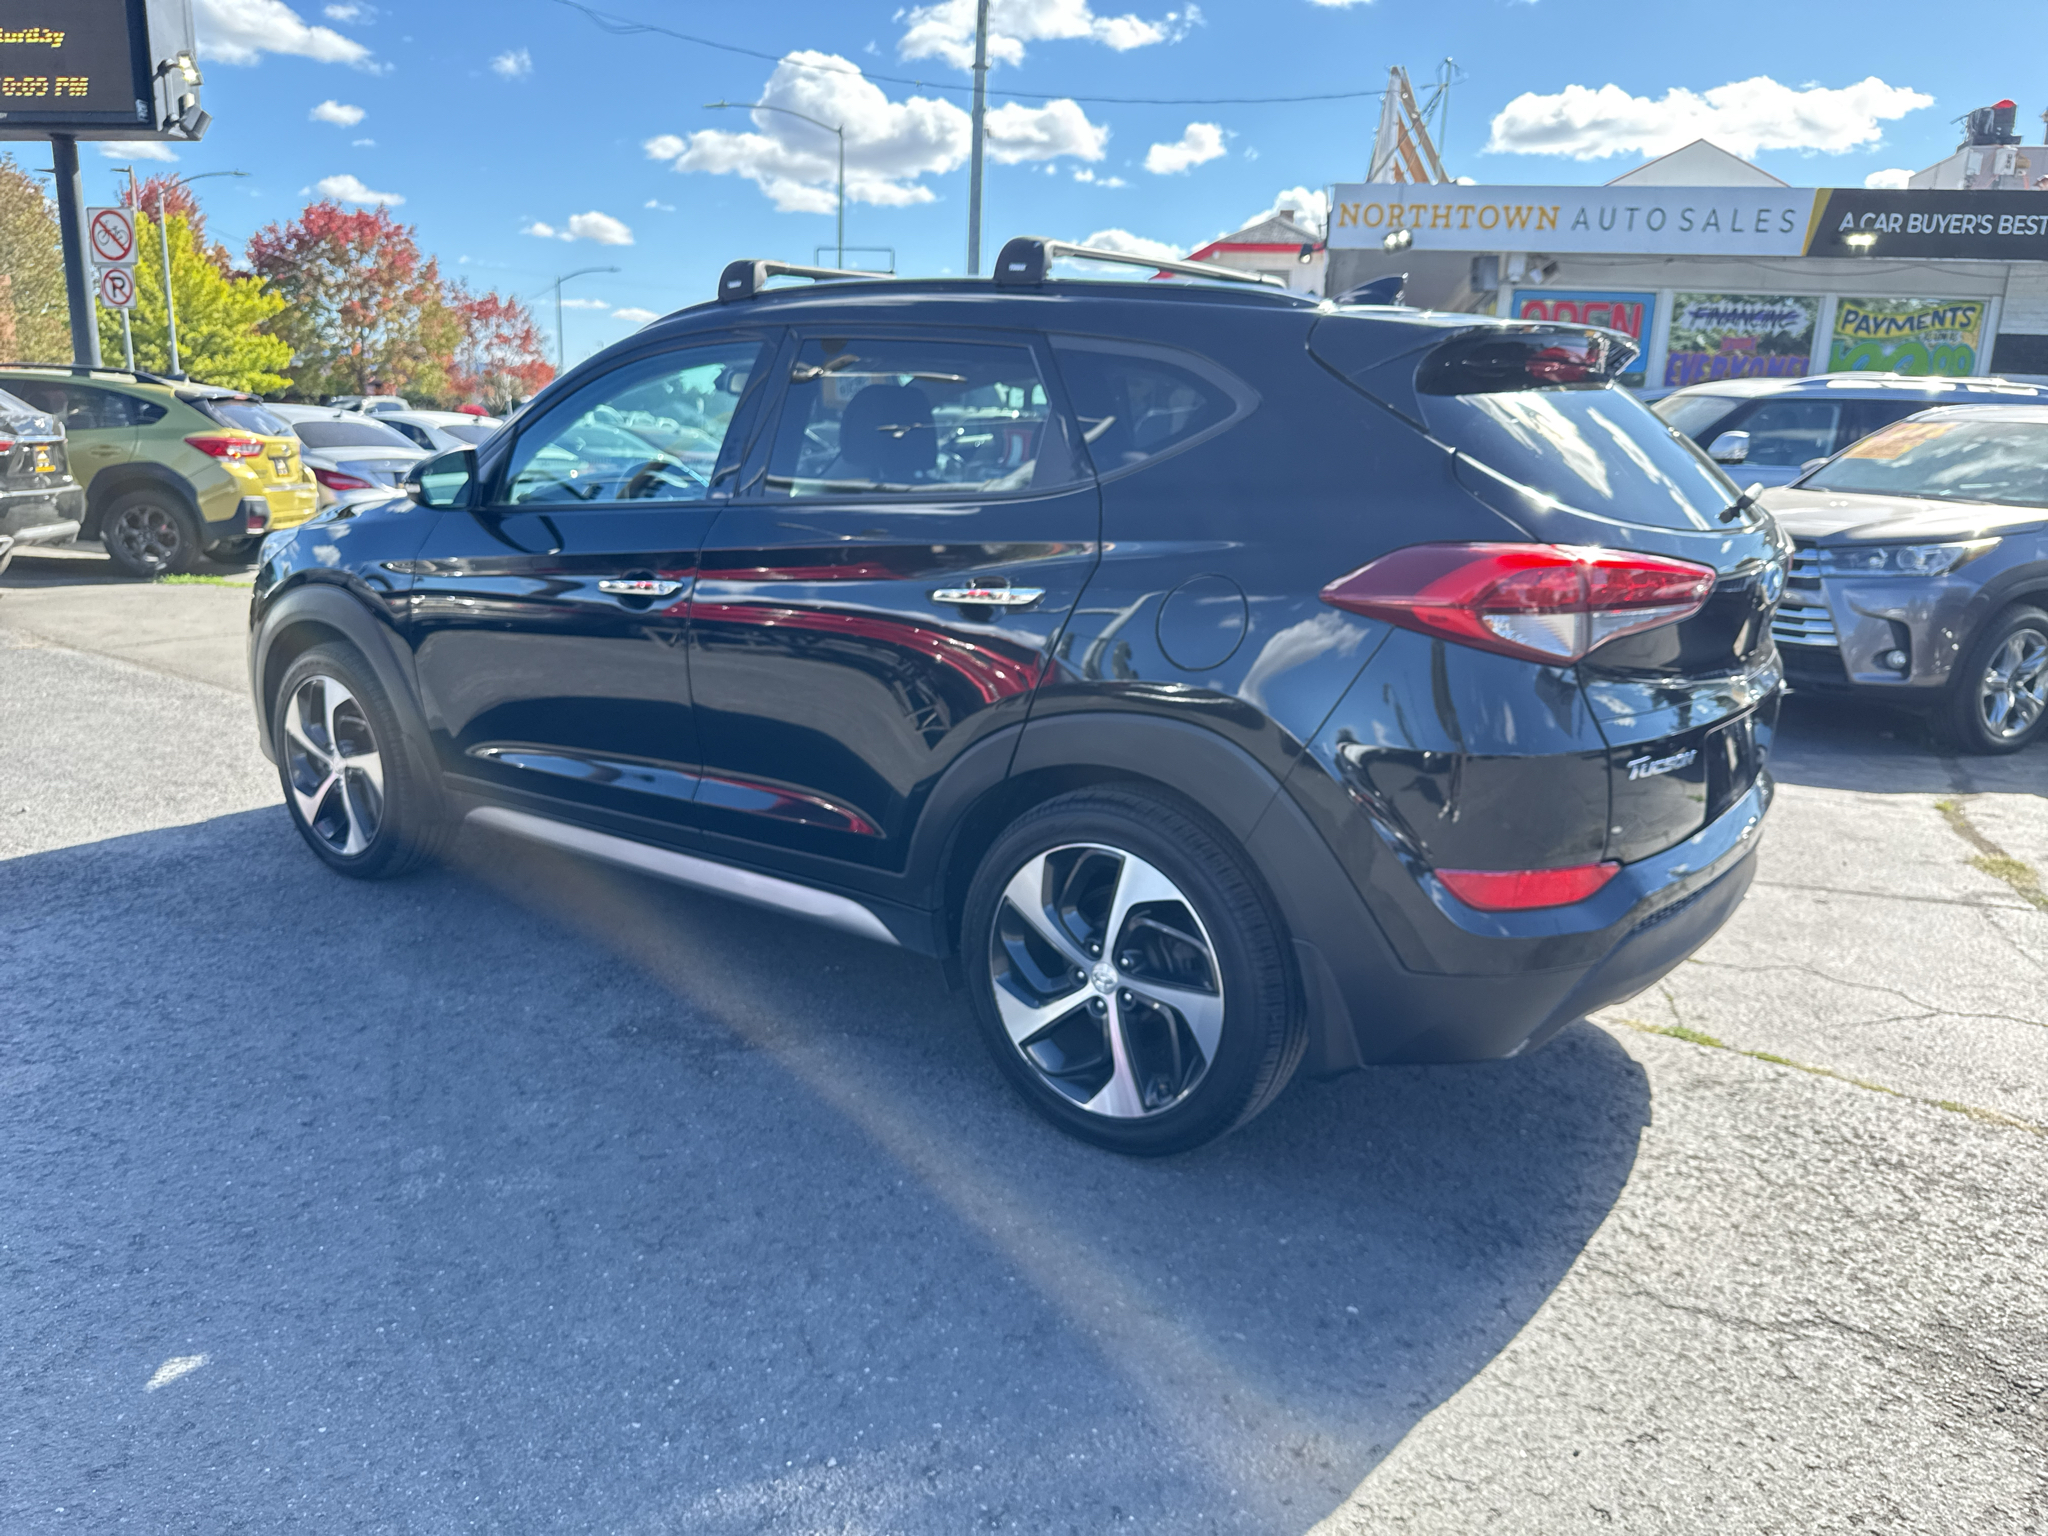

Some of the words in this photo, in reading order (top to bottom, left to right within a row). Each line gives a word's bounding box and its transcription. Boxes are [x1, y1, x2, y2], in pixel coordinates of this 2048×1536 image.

[54, 77, 89, 96] PM
[1338, 203, 1561, 230] NORTHTOWN
[1571, 206, 1668, 232] AUTO
[1678, 207, 1797, 233] SALES
[1838, 212, 1855, 232] A
[1859, 212, 1904, 234] CAR
[1906, 213, 1994, 235] BUYER'S
[1997, 214, 2048, 236] BEST
[1841, 306, 1976, 335] PAYMENTS
